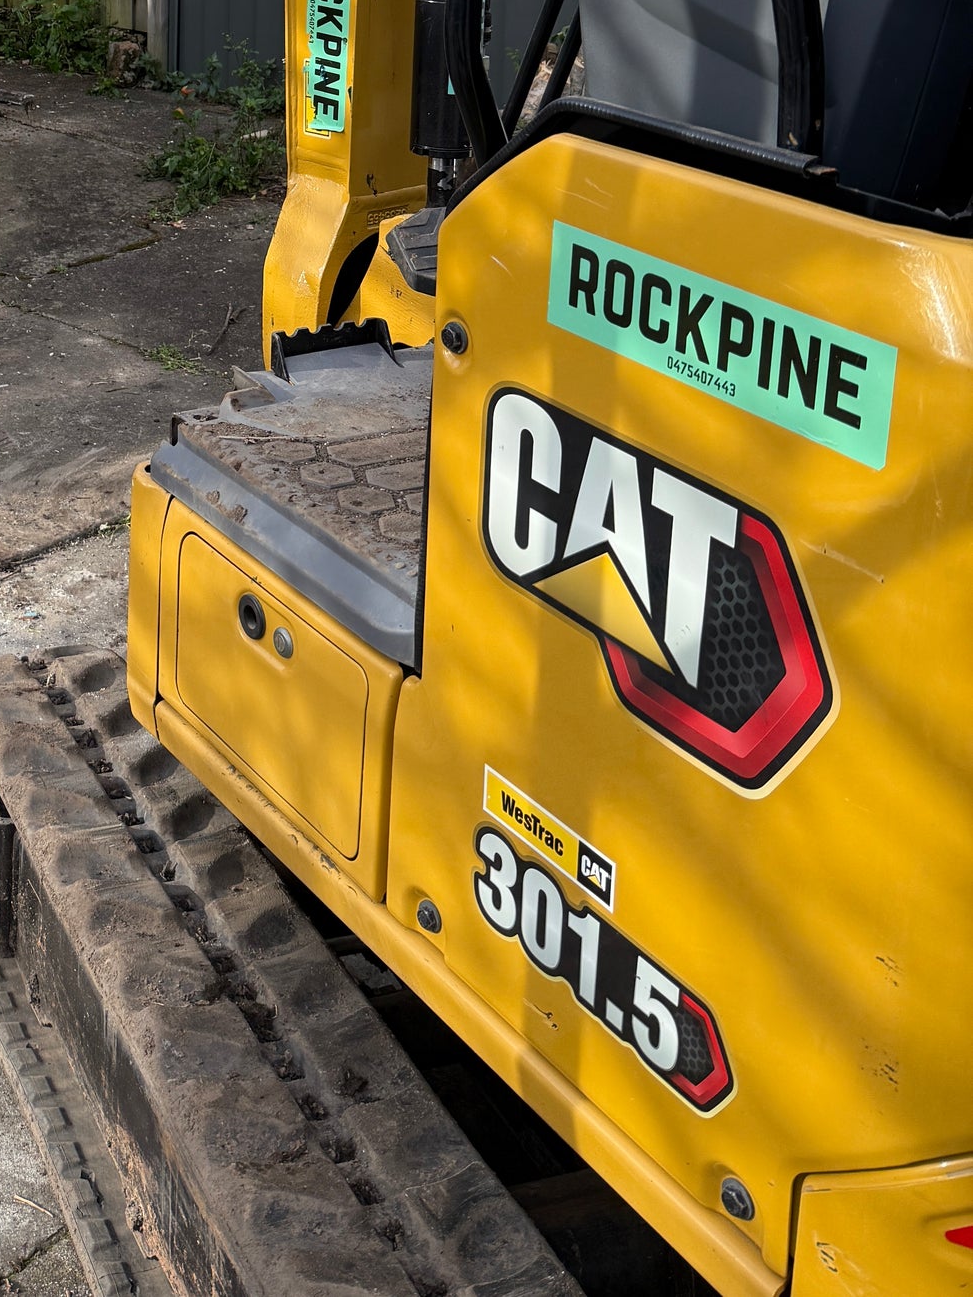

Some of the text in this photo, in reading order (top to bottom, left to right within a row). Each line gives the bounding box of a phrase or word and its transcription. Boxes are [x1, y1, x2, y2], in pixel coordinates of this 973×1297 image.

[568, 243, 868, 430] ROCKPINE
[666, 355, 736, 397] 0475407443
[487, 393, 739, 690] CAT
[501, 789, 610, 892] WesTrac CAT
[477, 832, 680, 1072] 301.5
